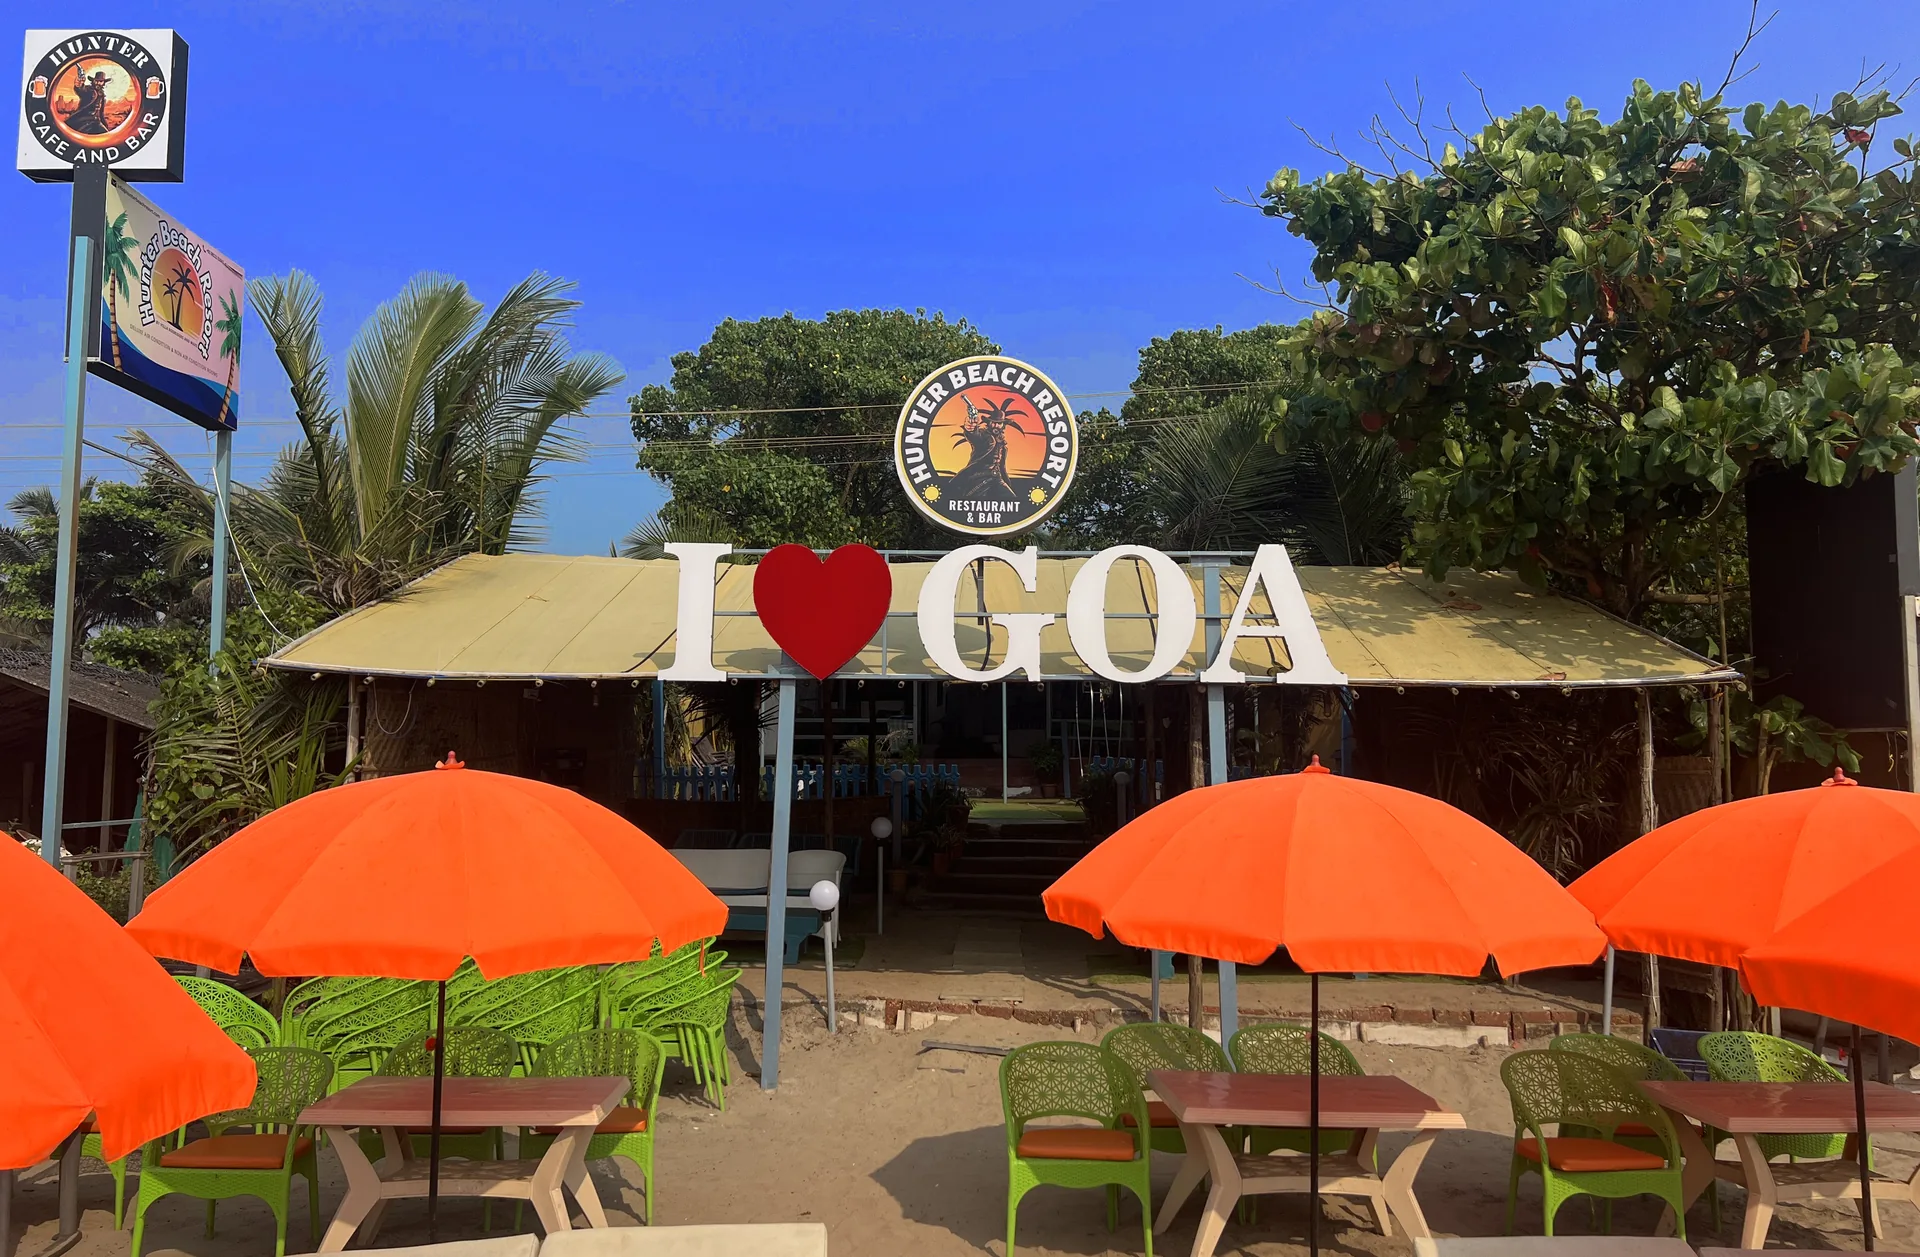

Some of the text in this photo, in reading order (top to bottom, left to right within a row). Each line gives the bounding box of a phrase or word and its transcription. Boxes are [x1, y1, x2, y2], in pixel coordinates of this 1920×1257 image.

[49, 35, 150, 69] HUNTER
[31, 111, 159, 163] CAFE AND BAR
[138, 220, 213, 360] Hunter Beach Resort
[151, 335, 171, 351] CONDITION
[904, 364, 1069, 489] HUNTER BEACH RESORT
[949, 500, 1020, 513] RESTAURANT
[967, 512, 1001, 524] & BAR
[657, 542, 1349, 685] I GOA
